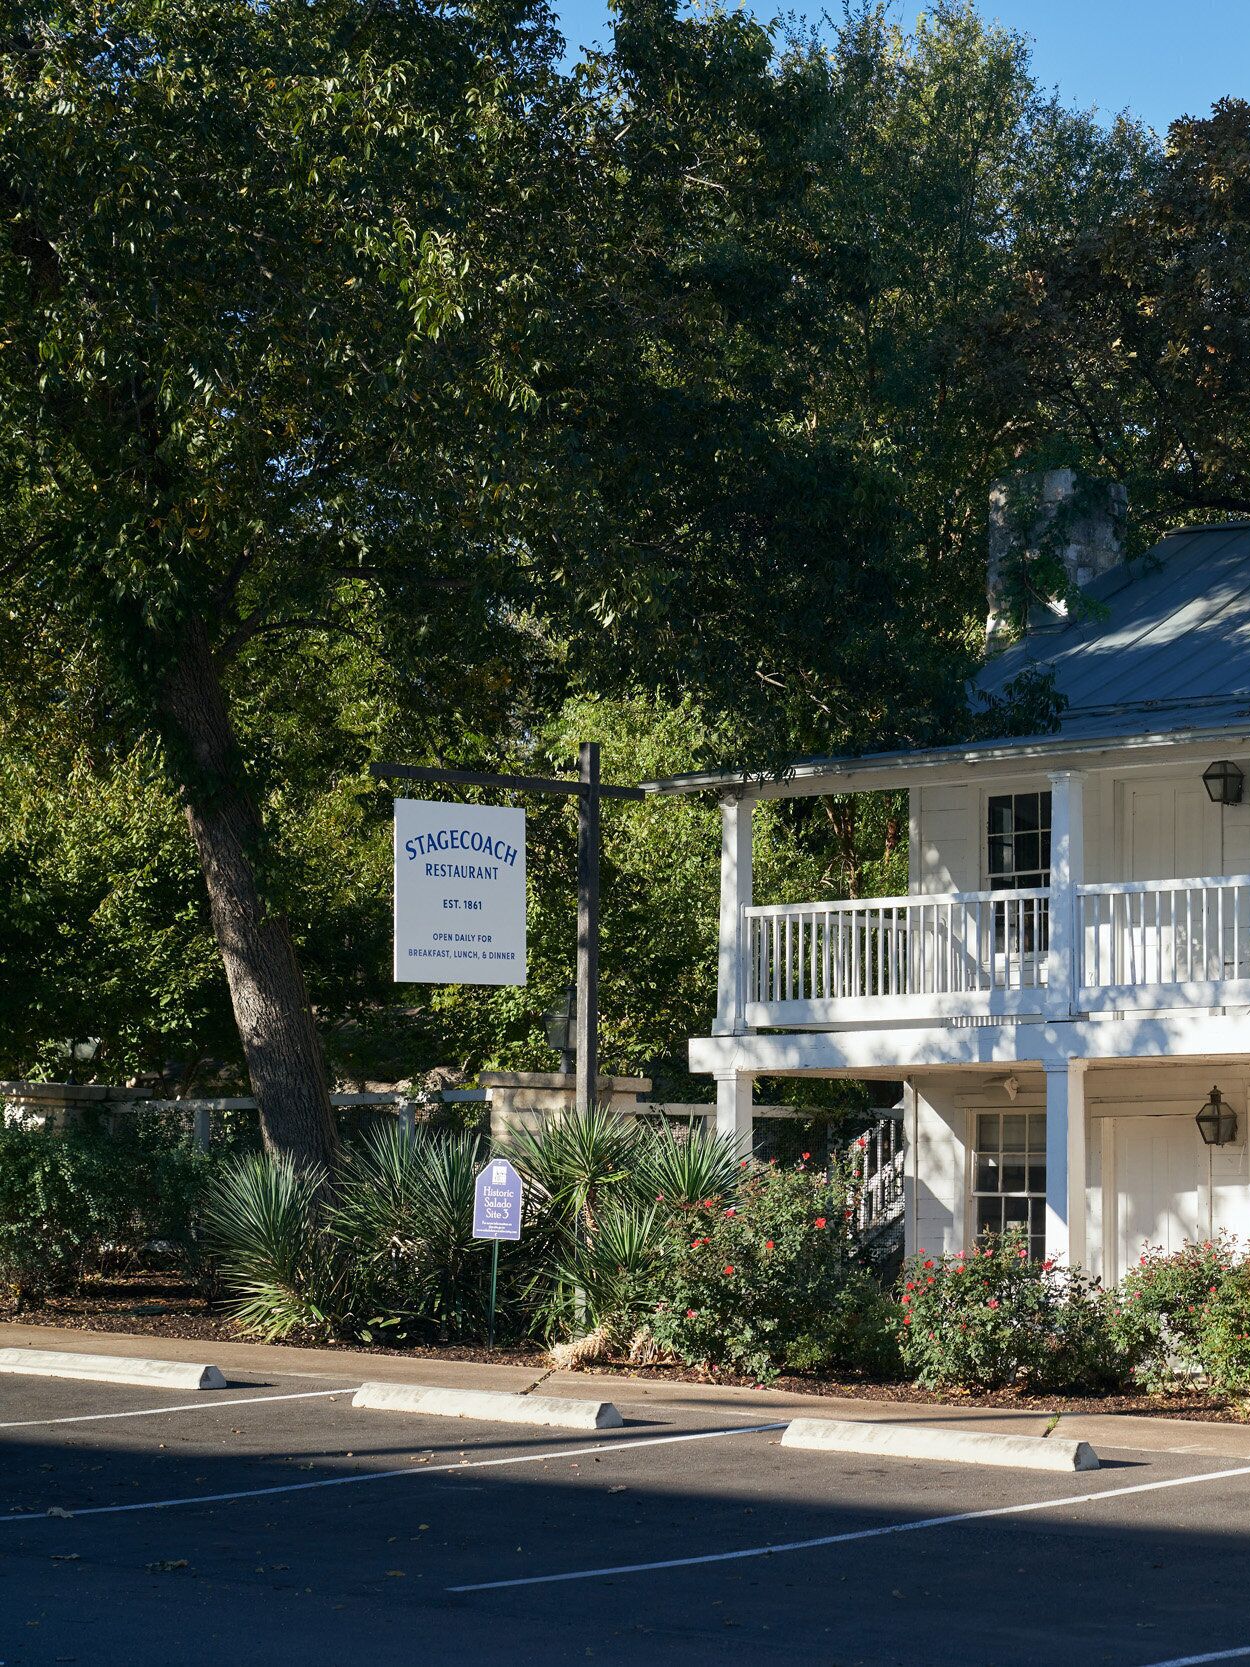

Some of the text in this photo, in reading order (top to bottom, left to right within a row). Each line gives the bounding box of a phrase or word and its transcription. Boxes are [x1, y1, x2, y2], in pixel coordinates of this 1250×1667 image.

[405, 830, 517, 866] STAGECOACH
[426, 863, 499, 880] RESTAURANT
[443, 899, 482, 910] EST. 1861
[433, 933, 452, 941] OPEN
[454, 934, 475, 942] DAILY
[408, 949, 515, 960] BREAKFAST, LUNCH, & DINNER
[483, 1186, 514, 1198] Historic
[485, 1197, 512, 1208] Salado
[486, 1208, 509, 1219] Site 3
